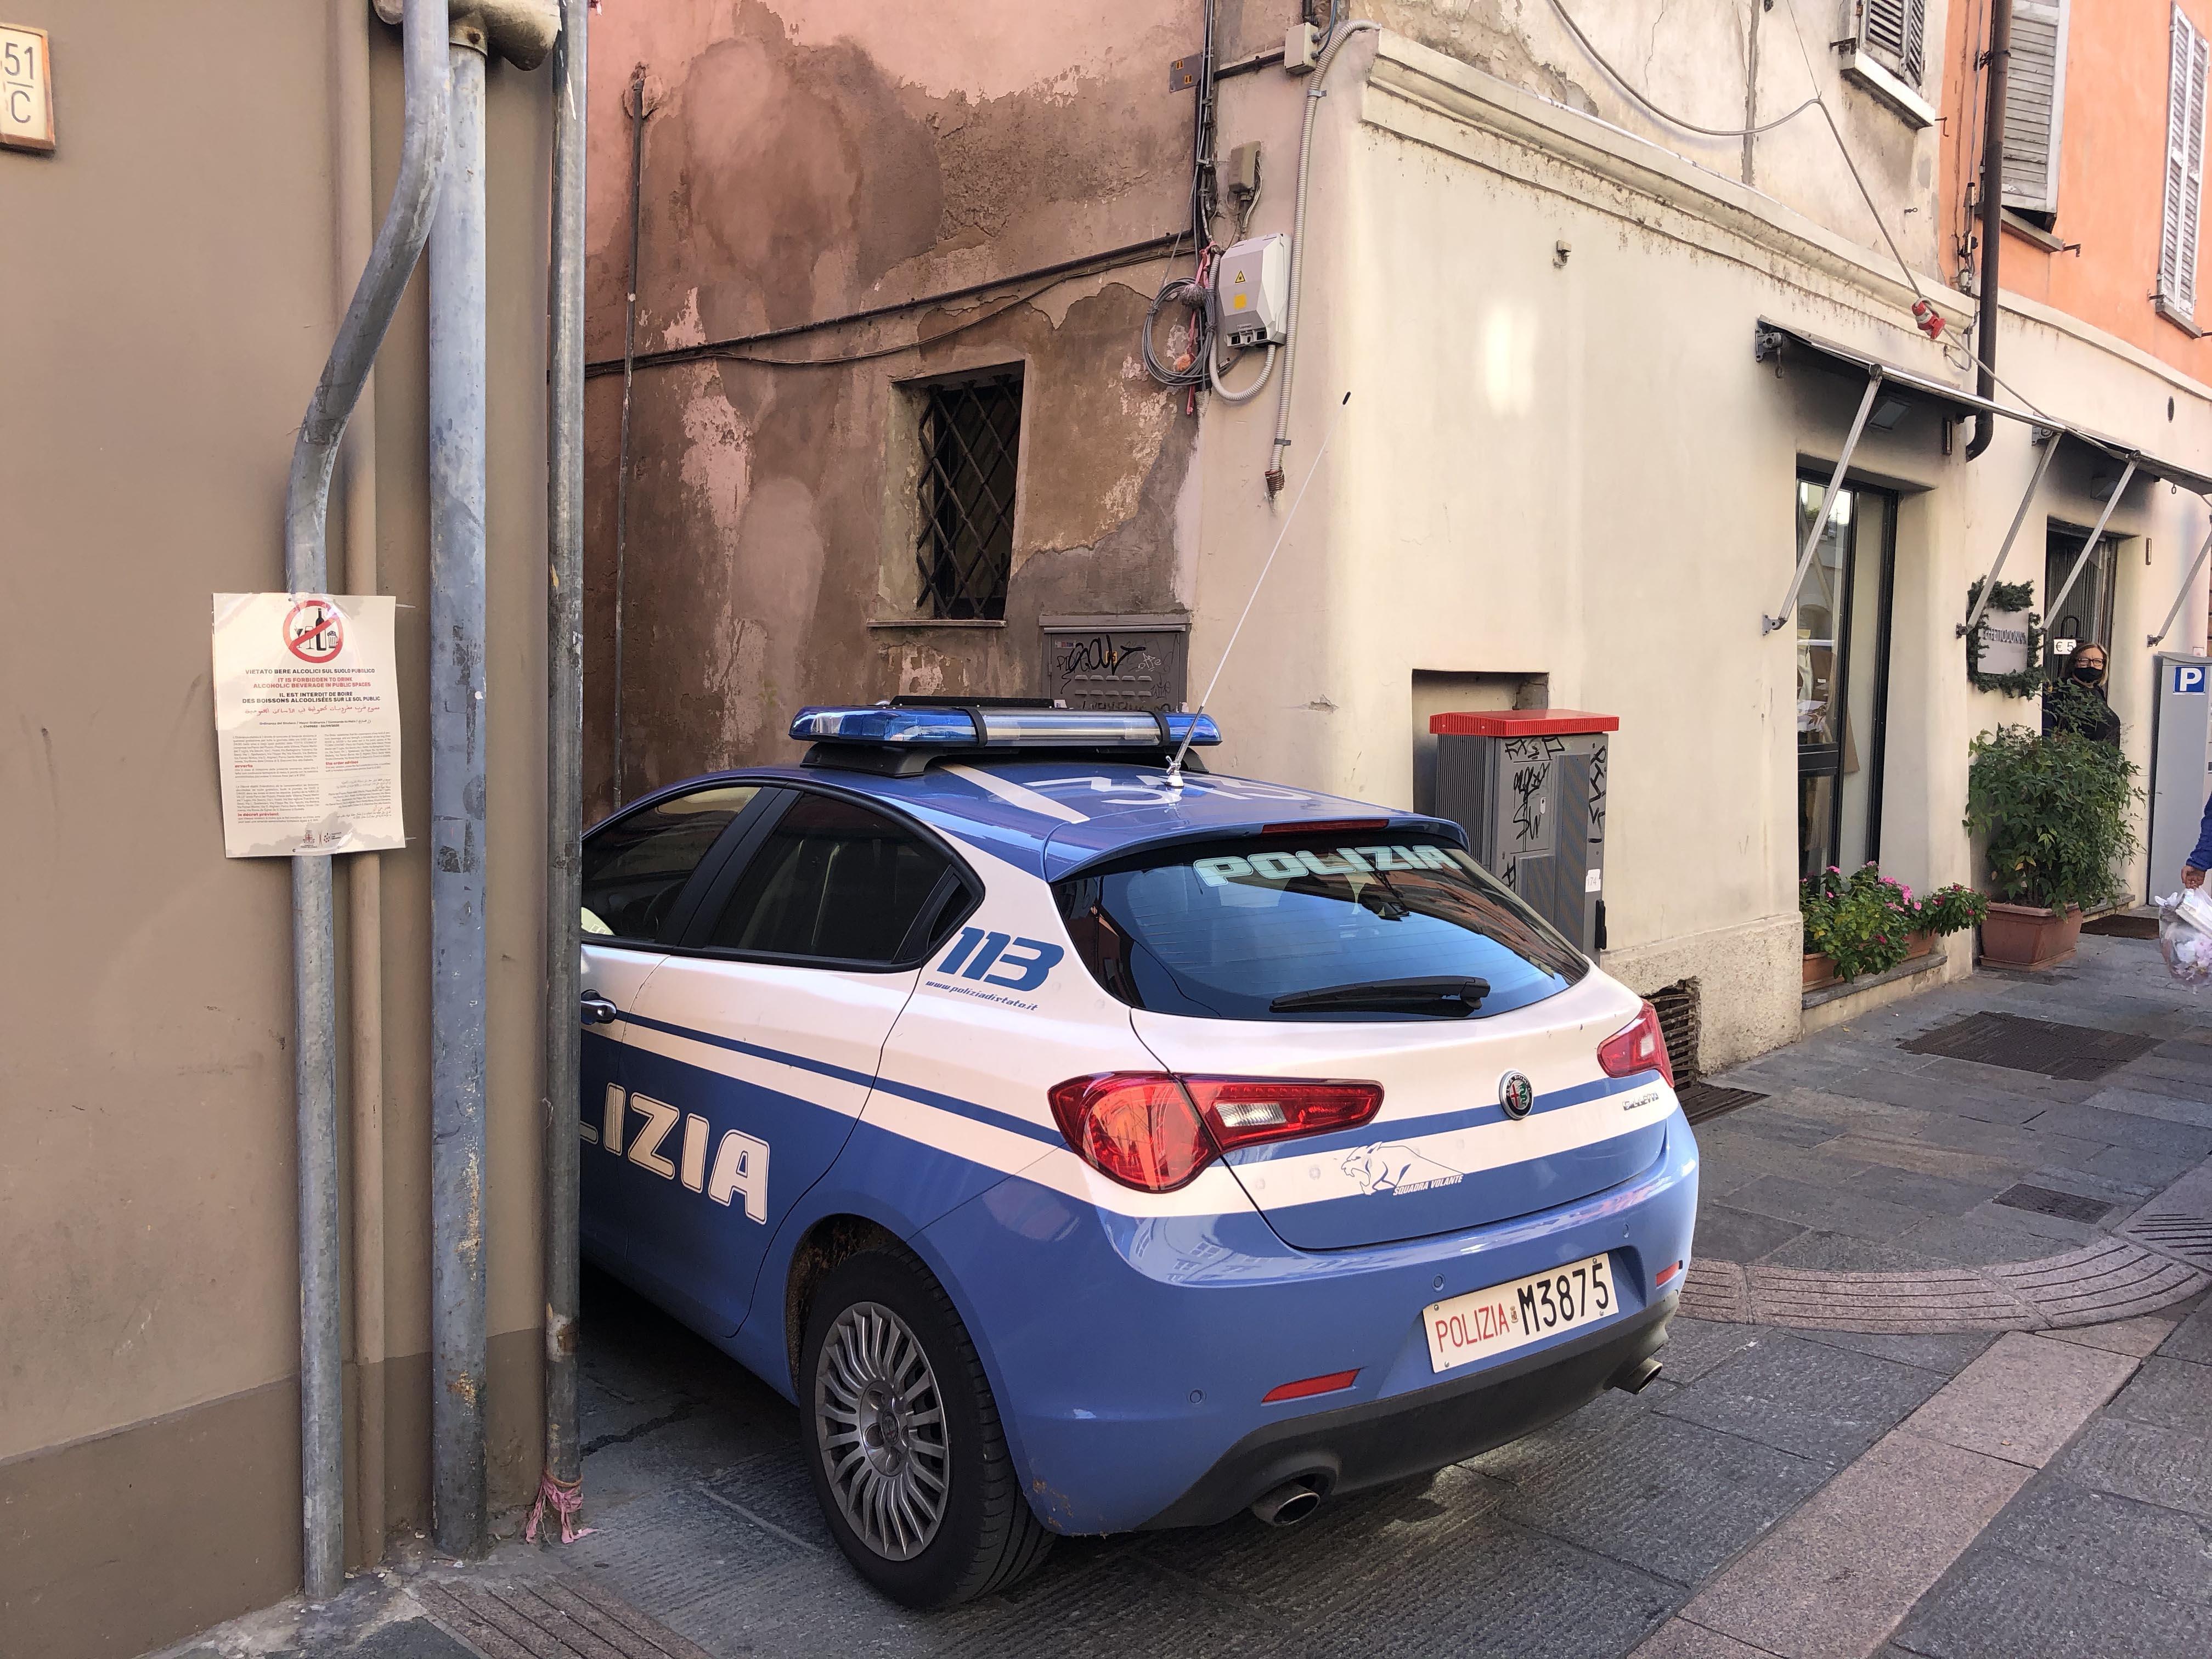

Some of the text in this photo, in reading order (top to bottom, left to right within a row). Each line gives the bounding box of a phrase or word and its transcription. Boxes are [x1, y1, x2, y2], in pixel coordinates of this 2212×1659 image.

[4, 42, 34, 80] 51
[11, 90, 31, 123] C
[2056, 641, 2063, 652] €
[2179, 668, 2202, 691] P
[1193, 845, 1463, 887] POLIZIA
[936, 926, 1065, 992] 113
[925, 980, 1039, 1011] www.poliziadistato.it
[580, 1082, 770, 1225] IZIA
[1392, 1174, 1464, 1196] SQUADRA VOLANTE
[1435, 1262, 1609, 1353] POLIZIA M3875
